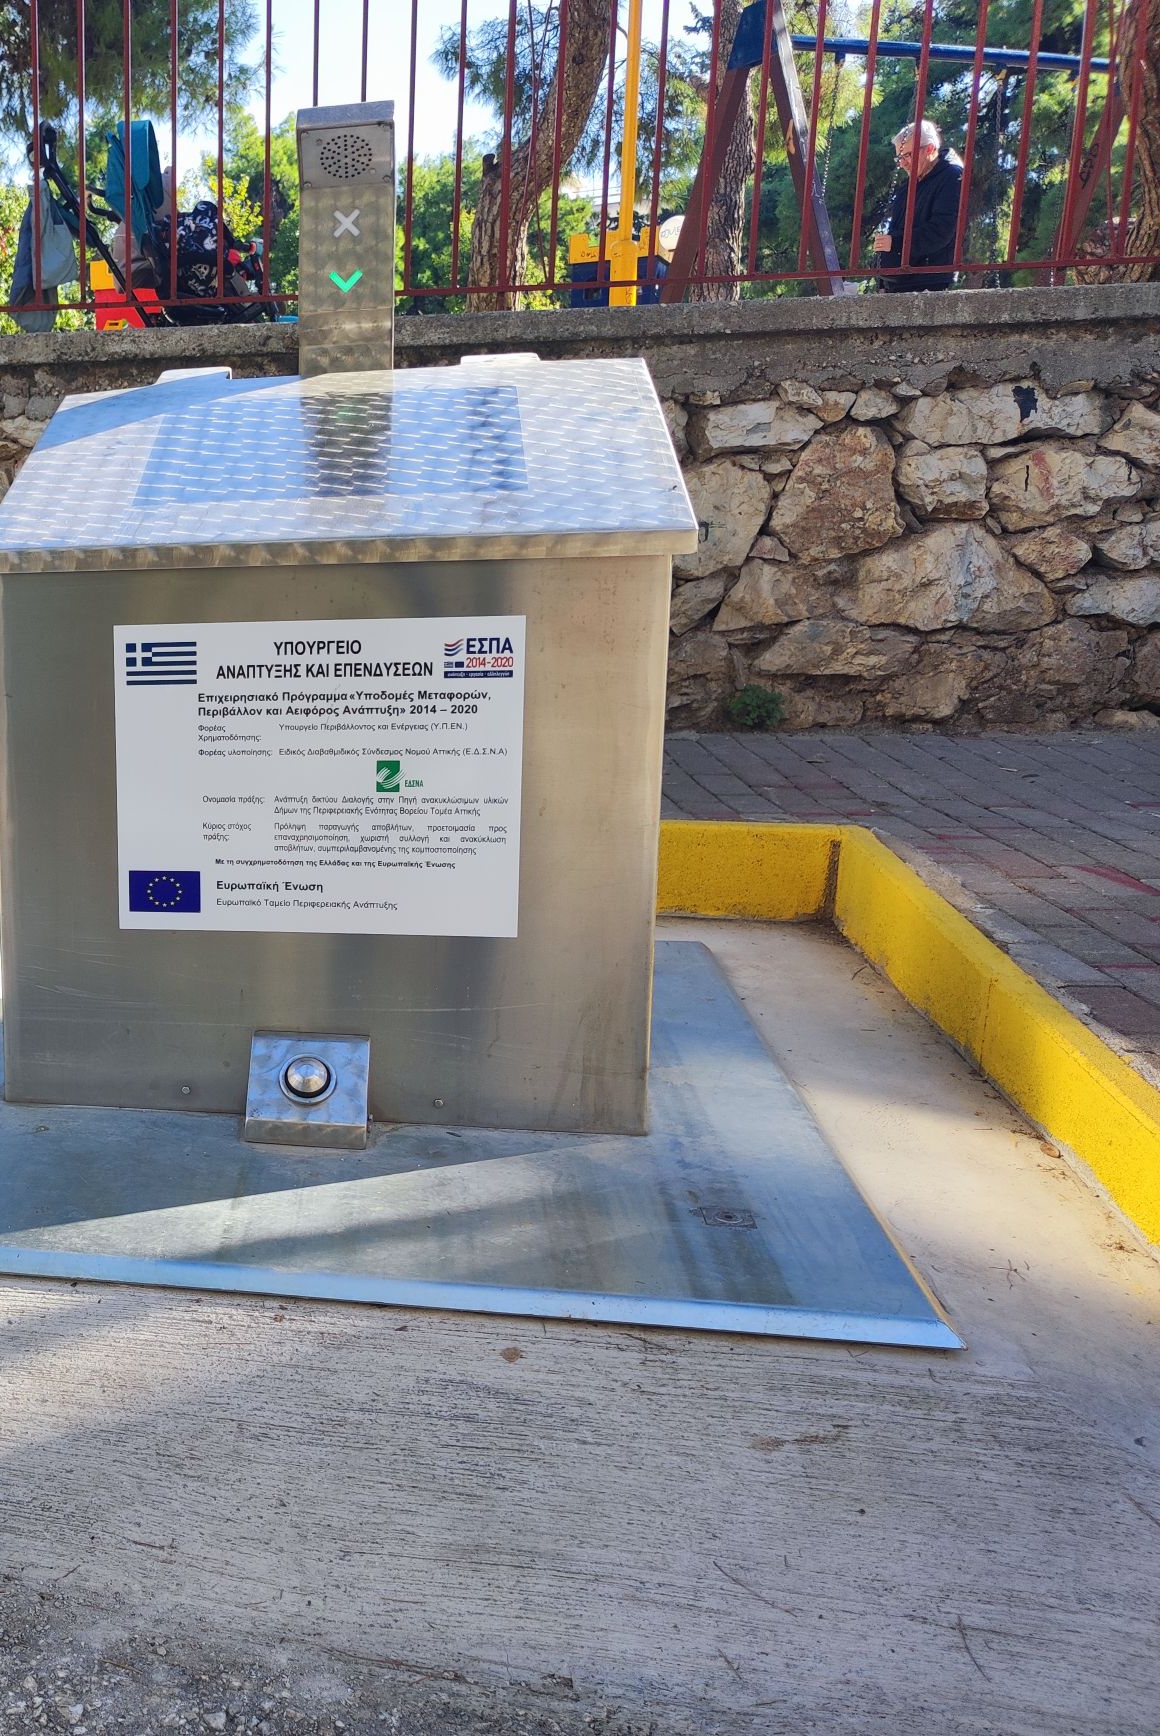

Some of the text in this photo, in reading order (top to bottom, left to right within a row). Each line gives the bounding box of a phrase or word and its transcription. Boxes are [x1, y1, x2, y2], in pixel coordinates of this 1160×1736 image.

[273, 640, 362, 656] ΥΠΟΥΡΓΕΙΟ
[466, 638, 513, 654] ΕΣΠΑ
[466, 657, 513, 668] 2014-2020
[216, 662, 433, 679] ΑΝΑΠΤΥΞΗΣ ΚΑΙ ΕΠΕΝΔΥΣΕΩΝ
[198, 690, 491, 704] Επιχειρησιακό Πρόγραμμα «Υποδομές Μεταφορών,
[198, 707, 262, 718] Περιβάλλον
[285, 704, 340, 716] Αειφόρος
[343, 706, 406, 716] Ανάπτυξη»
[410, 705, 437, 714] 2014
[451, 705, 478, 714] 2020
[279, 723, 319, 732] Υπουργείο
[321, 723, 375, 731] Περιβάλλοντος
[391, 723, 428, 731] Ενέργειας
[431, 723, 467, 731] (Υ.Π.ΕΝ.)
[198, 748, 272, 757] Φορέας υλοποίησης:
[307, 747, 360, 758] Διαβαθμιδικός
[362, 748, 402, 756] Σύνδεσμος
[405, 748, 430, 756] Νομού
[433, 748, 460, 756] Αττικής
[203, 796, 236, 804] Ονομασία
[274, 796, 308, 804] Ανάπτυξη
[341, 795, 374, 805] Διαλογής
[398, 796, 417, 804] Πηγή
[421, 796, 479, 804] ανακυκλώσιμων
[484, 796, 508, 804] υλικών
[274, 807, 297, 815] Δήμων
[313, 806, 362, 816] Περιφερειακής
[365, 807, 397, 816] Ενότητας
[400, 807, 427, 816] Βορείου
[430, 807, 452, 816] Τομέα
[454, 807, 480, 816] Αττικής
[203, 823, 251, 831] Κύριος στόχος
[274, 823, 306, 831] Πρόληψη
[319, 823, 360, 833] παραγωγής
[428, 825, 475, 833] προετοιμασία
[360, 835, 389, 843] χωριστή
[399, 835, 429, 843] συλλογή
[460, 836, 506, 844] ανακύκλωση
[412, 846, 476, 855] κομποστοποίησης
[319, 859, 349, 867] Ελλάδας
[216, 881, 279, 892] Ευρωπαϊκή
[264, 899, 290, 907] Ταμείο
[293, 899, 350, 909] Περιφερειακής
[353, 901, 398, 910] Ανάπτυξης
